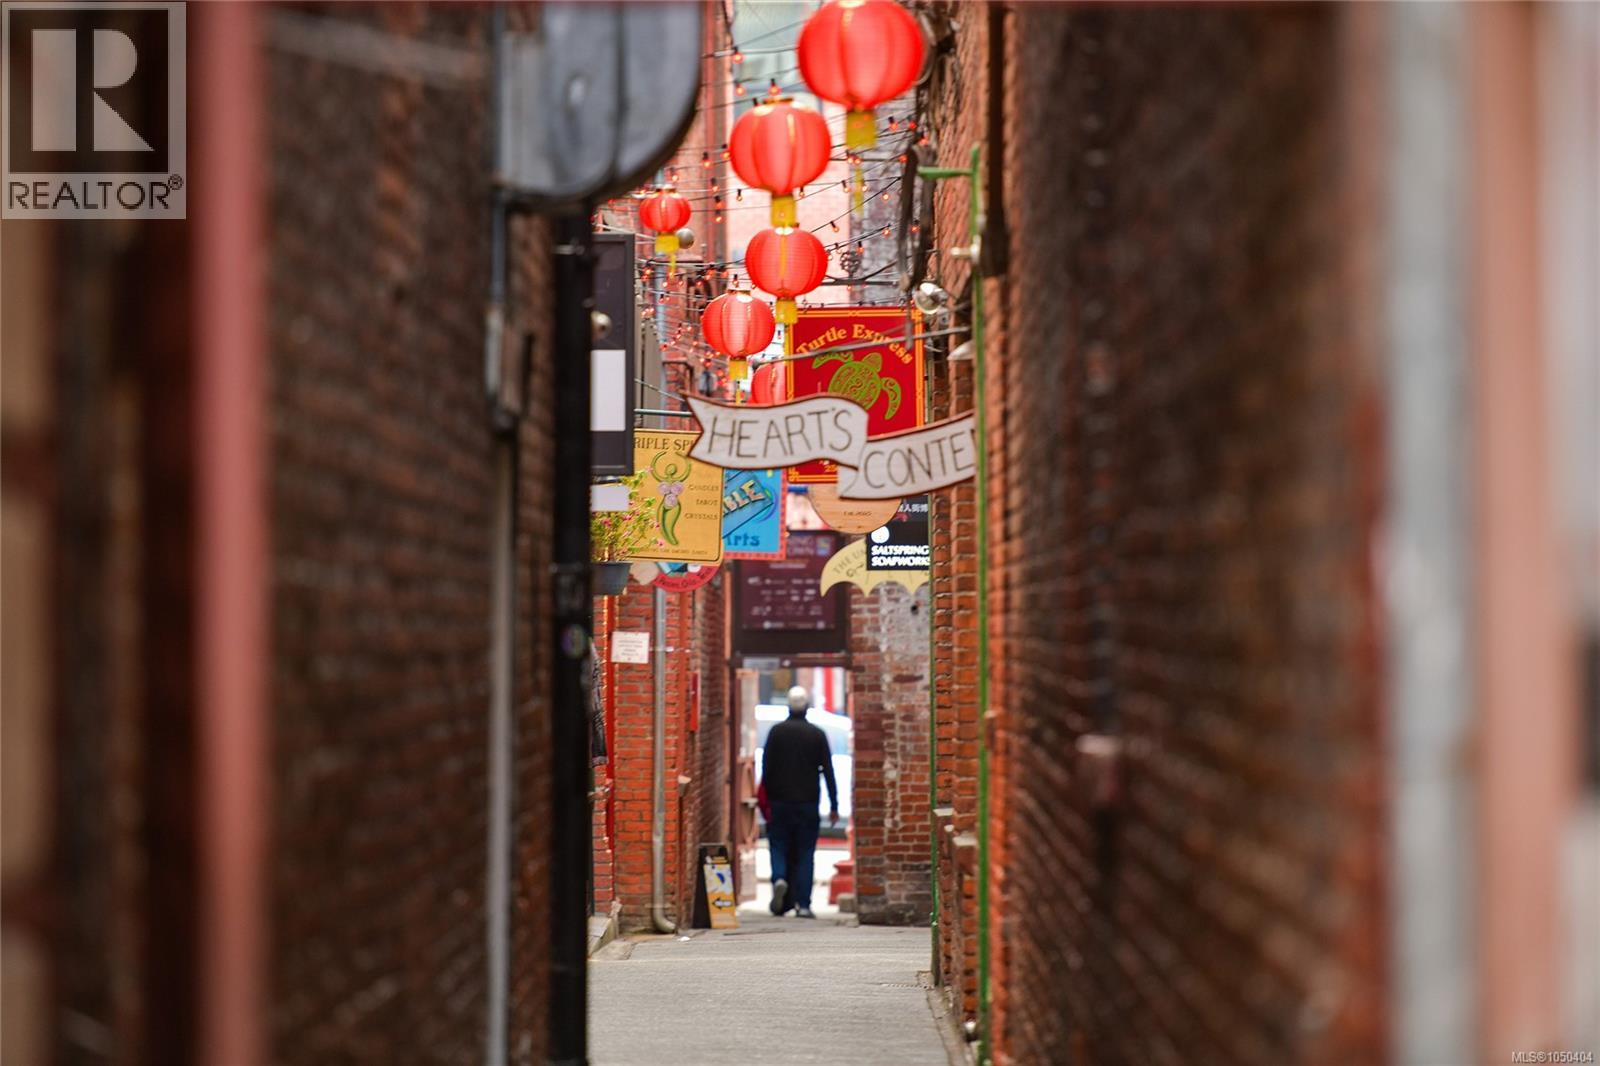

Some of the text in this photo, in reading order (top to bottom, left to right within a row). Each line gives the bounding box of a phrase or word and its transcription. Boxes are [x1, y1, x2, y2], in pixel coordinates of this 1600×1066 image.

[796, 326, 848, 354] Turtle
[707, 406, 853, 459] HEART'S
[871, 544, 930, 556] SALTSPRING
